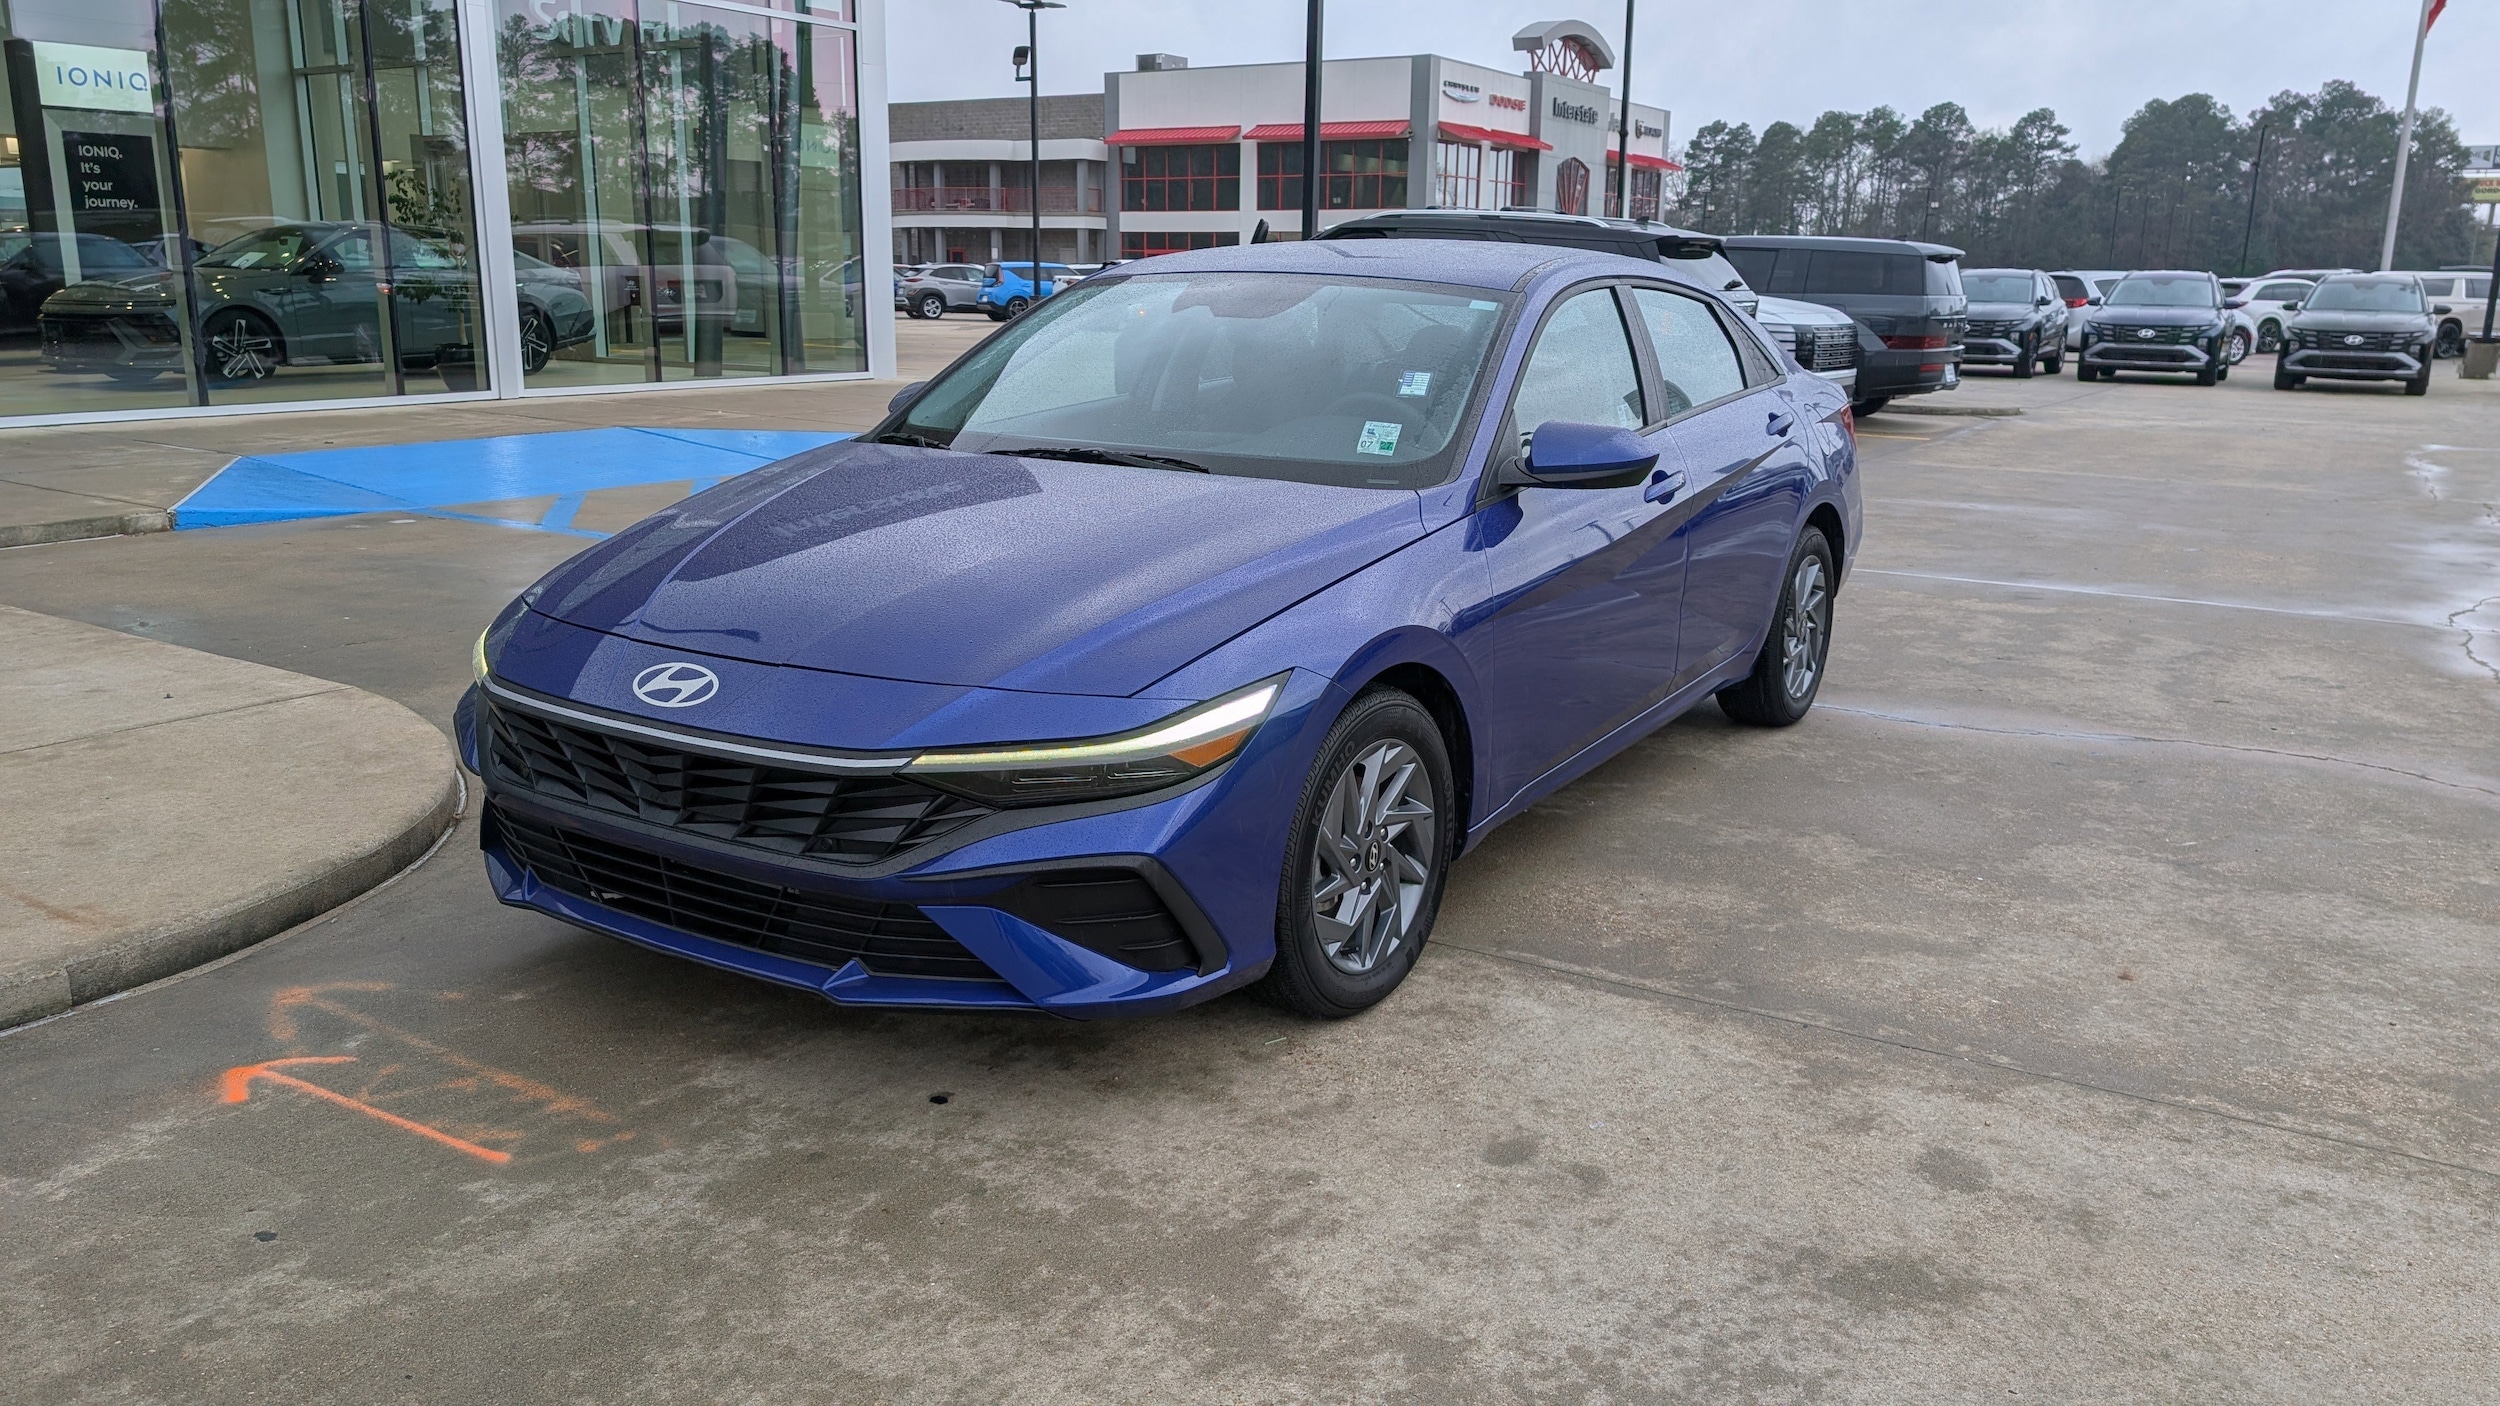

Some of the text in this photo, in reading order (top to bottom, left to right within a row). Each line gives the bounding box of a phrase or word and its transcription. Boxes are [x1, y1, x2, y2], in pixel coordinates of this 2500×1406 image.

[56, 65, 148, 92] IONIQ
[1489, 94, 1526, 112] DODGE
[1552, 96, 1599, 124] Interstate
[78, 144, 123, 160] IONIQ.
[80, 161, 101, 174] It's
[82, 180, 113, 193] your
[84, 194, 139, 211] journey.
[1360, 440, 1374, 448] 07
[1380, 441, 1393, 450] 27
[1310, 740, 1358, 828] KUMHO
